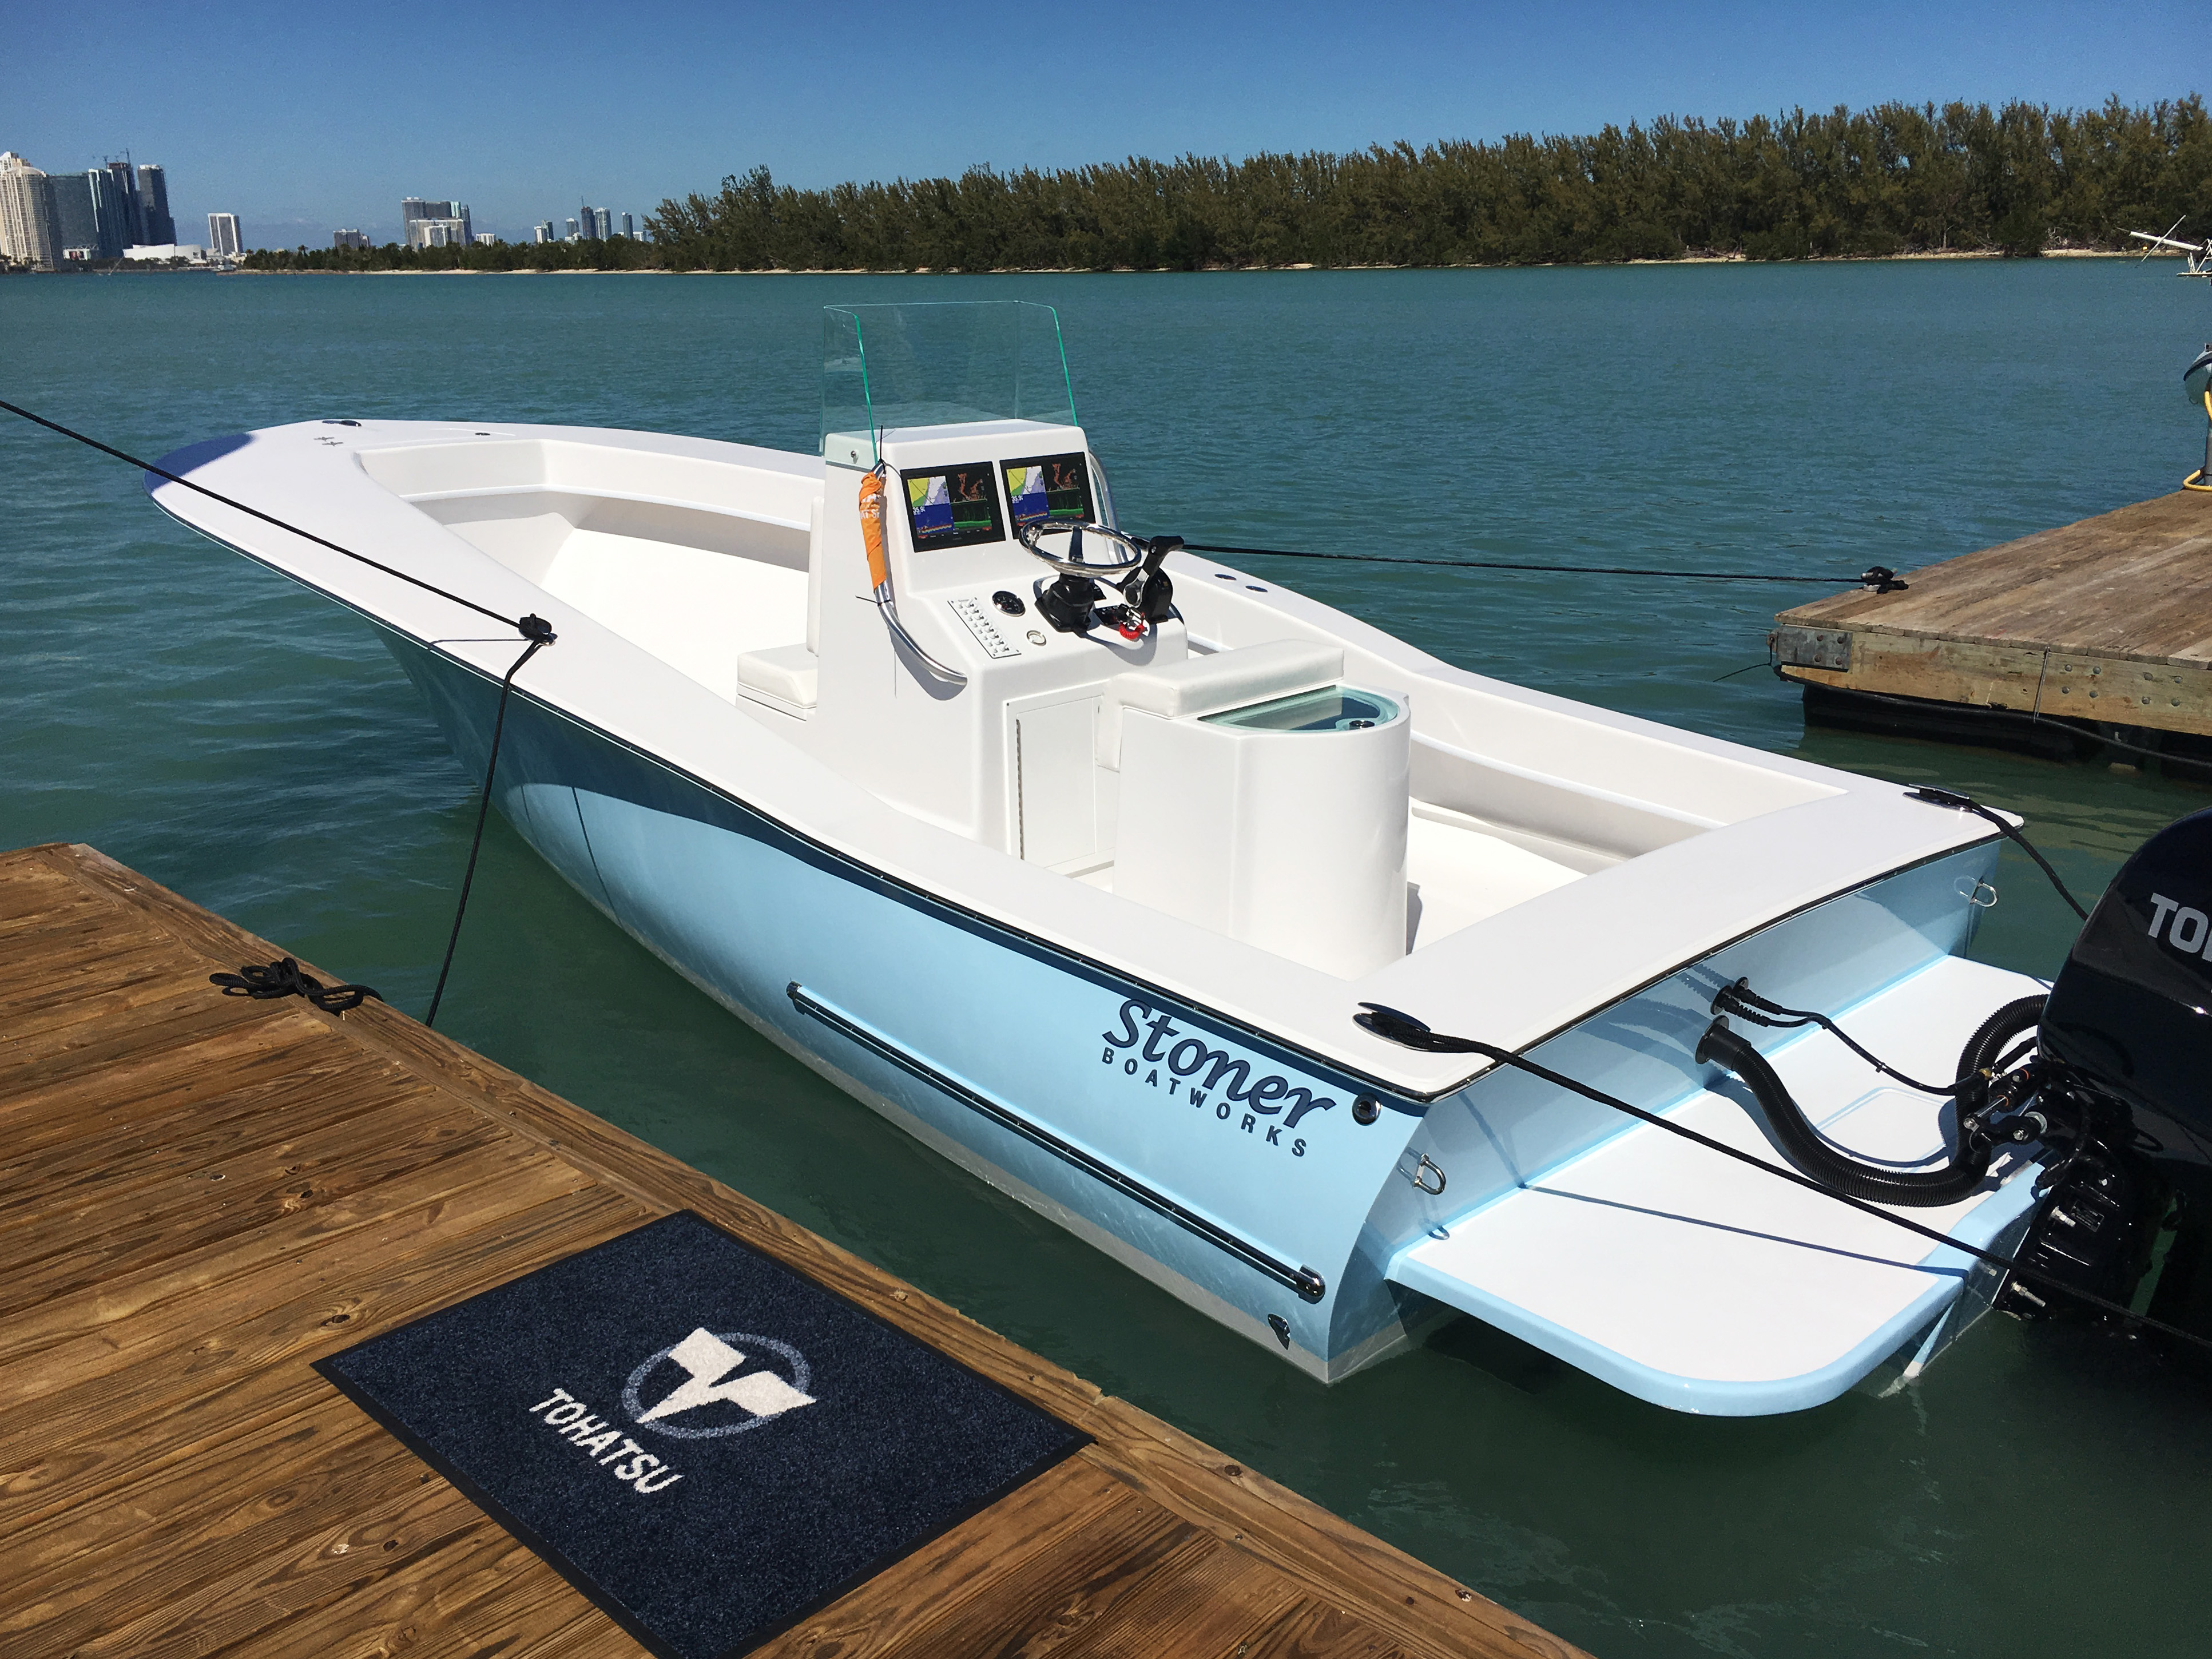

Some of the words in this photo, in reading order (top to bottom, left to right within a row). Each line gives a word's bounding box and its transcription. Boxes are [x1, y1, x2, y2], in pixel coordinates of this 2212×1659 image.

[2147, 892, 2212, 962] TO
[1102, 999, 1337, 1129] Stoner
[1102, 1047, 1306, 1157] BOATWORKS
[529, 1388, 684, 1494] TOHATSU
